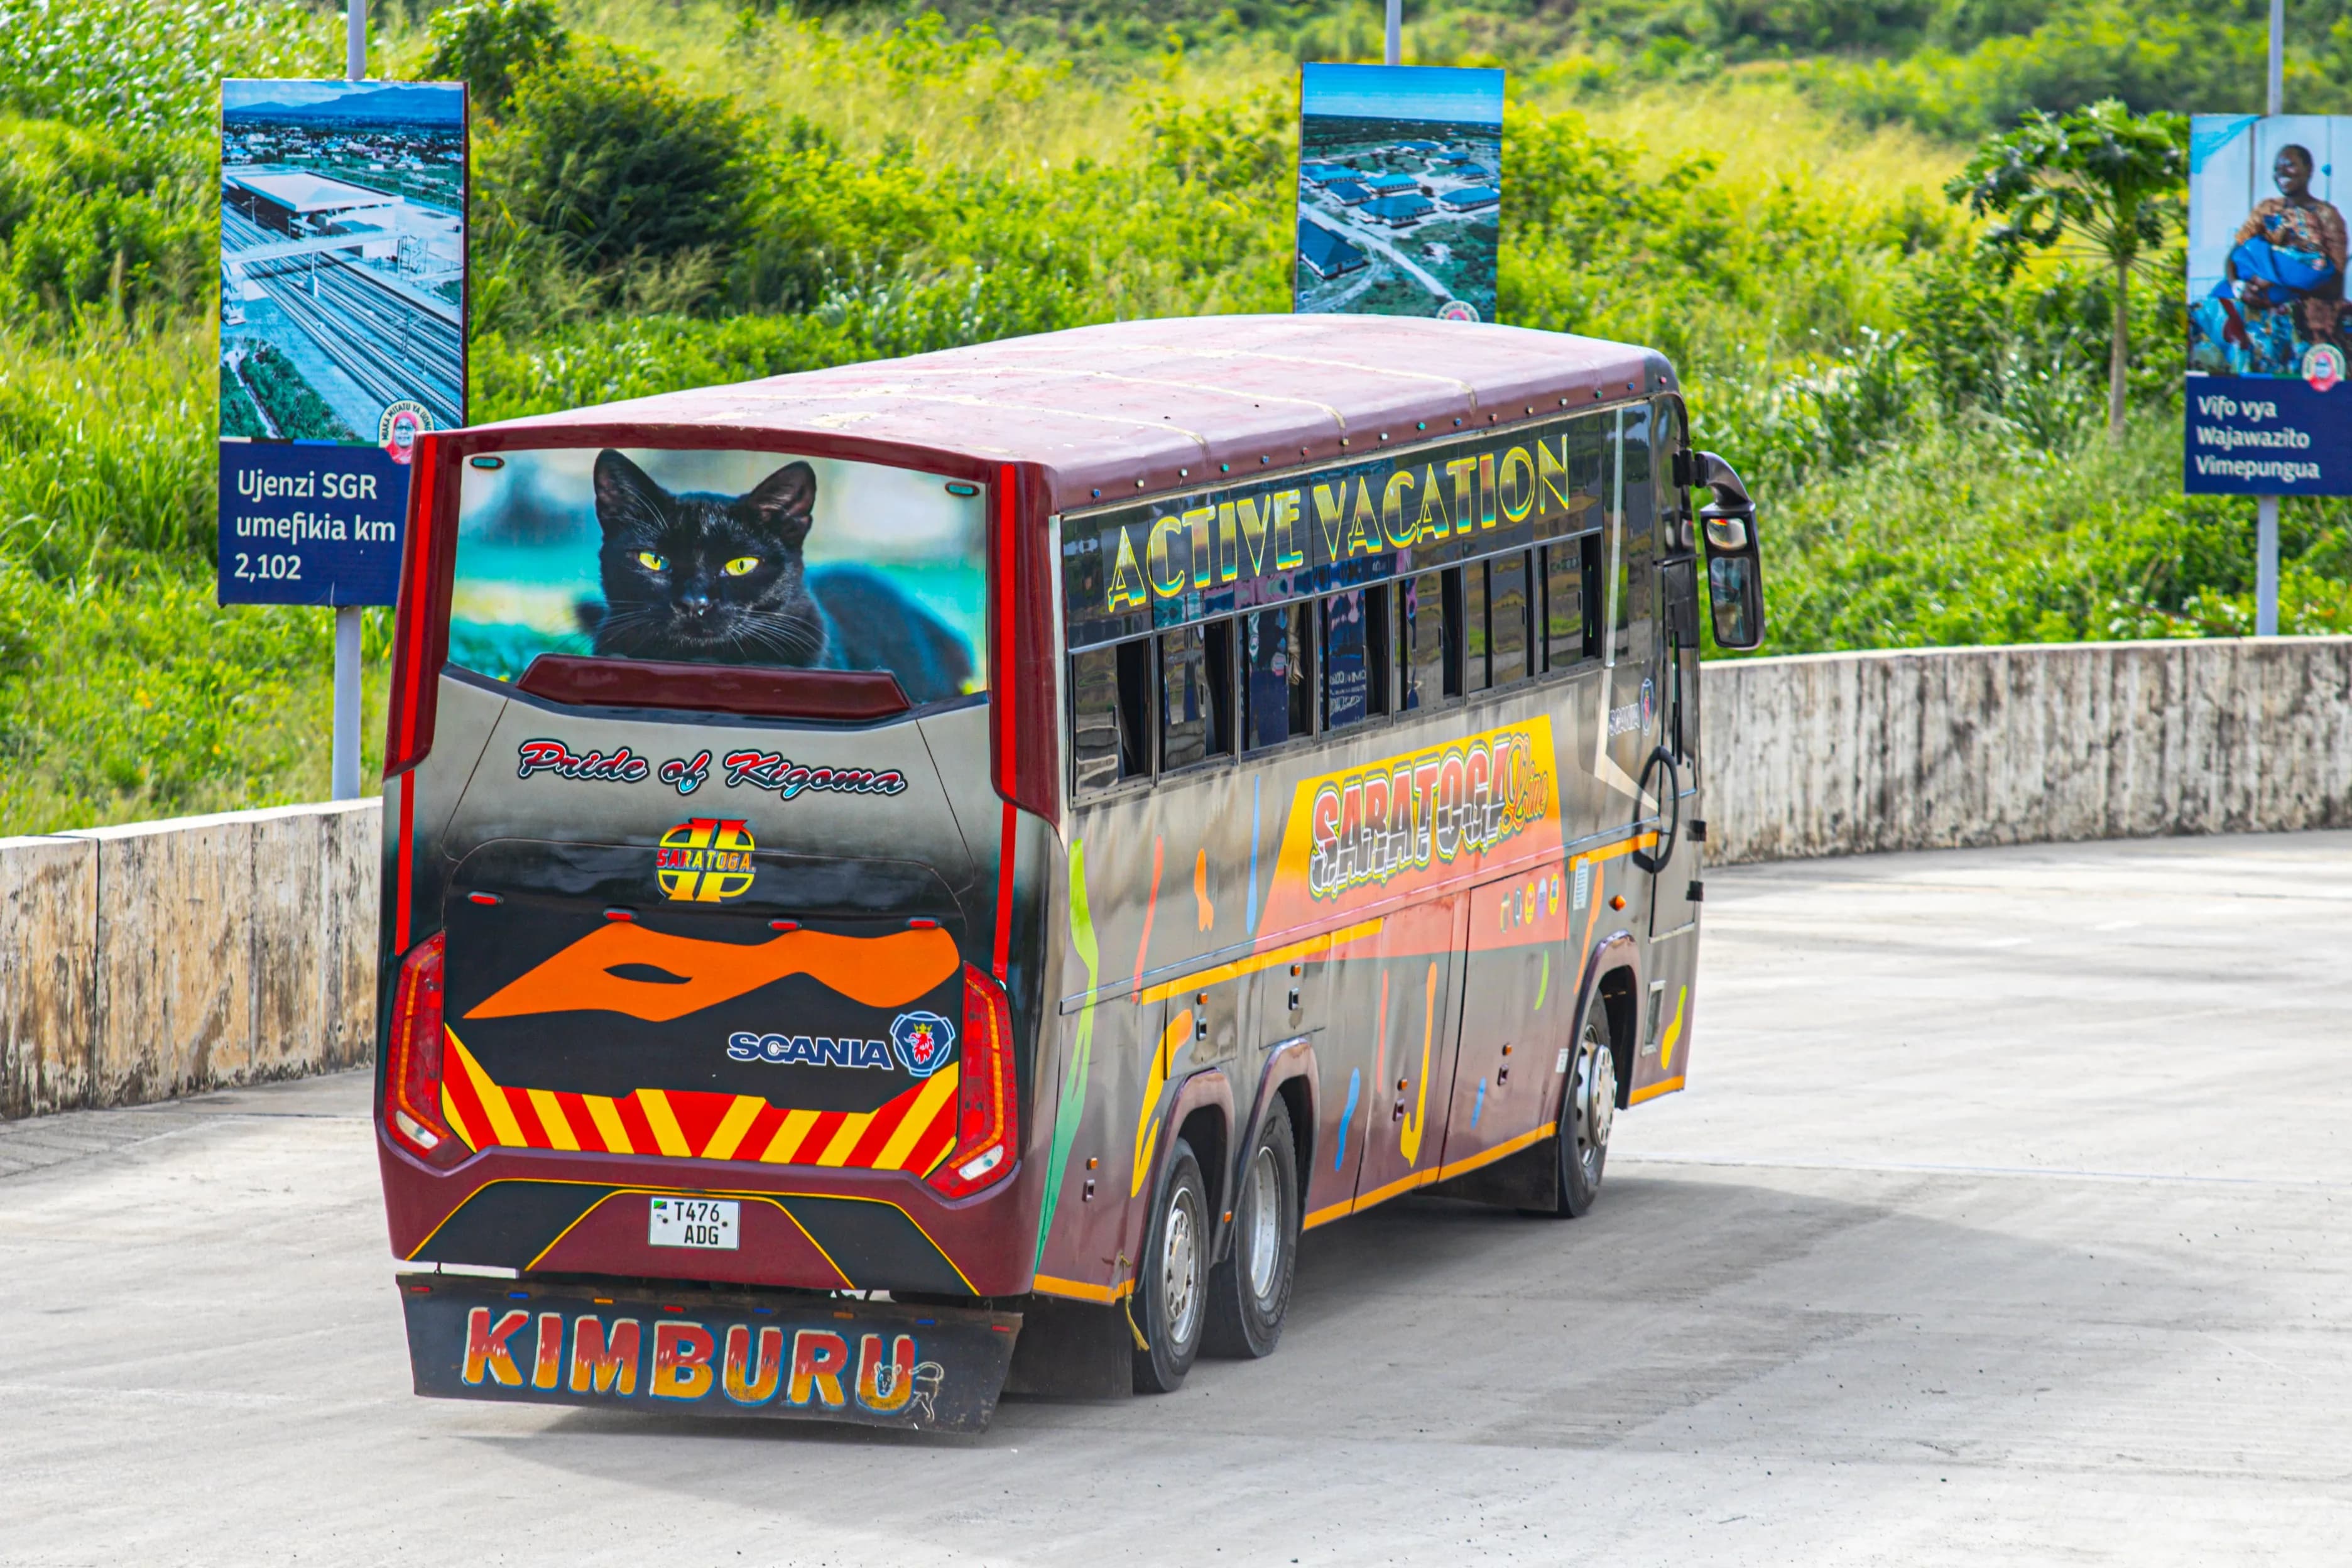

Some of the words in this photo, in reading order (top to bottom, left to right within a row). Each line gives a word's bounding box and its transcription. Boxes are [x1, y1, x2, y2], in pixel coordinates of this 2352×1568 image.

[2197, 395, 2237, 421] Vifo
[2239, 400, 2277, 422] vya
[2196, 425, 2311, 451] Wajawazito
[2194, 454, 2321, 483] Vimepungua
[237, 469, 315, 503] Ujenzi
[322, 472, 377, 499] SGR
[236, 512, 347, 545] umefikia
[354, 514, 396, 542] km
[1108, 489, 1304, 612] ACTIVE
[1313, 433, 1569, 562] VACATION
[234, 552, 302, 582] 2,102
[518, 739, 650, 781] Pride
[660, 750, 712, 793] of
[726, 750, 908, 799] Kigoma
[1310, 734, 1513, 900] SARATOGA
[727, 1032, 895, 1071] SCANIA
[674, 1201, 719, 1222] T476
[684, 1224, 719, 1245] ADG
[462, 1307, 918, 1413] KIMBURU
